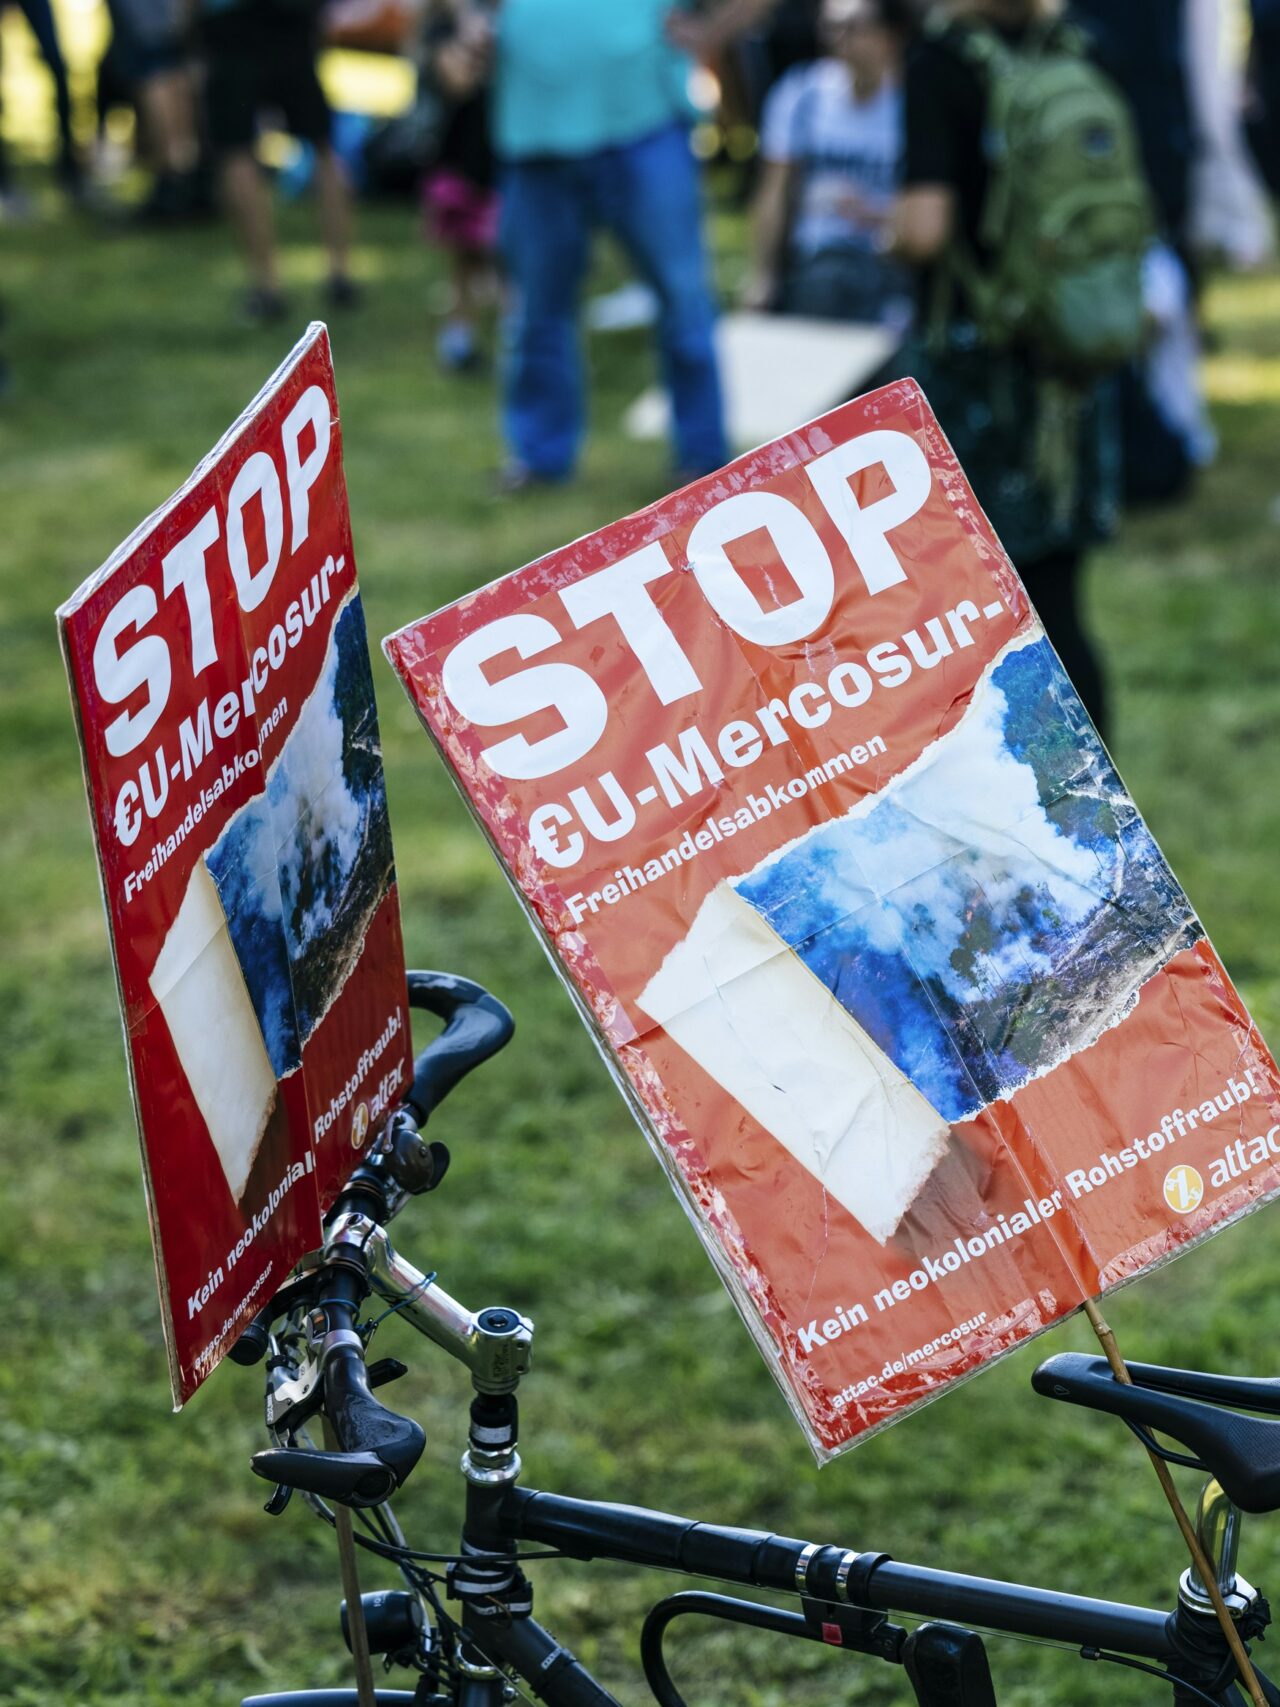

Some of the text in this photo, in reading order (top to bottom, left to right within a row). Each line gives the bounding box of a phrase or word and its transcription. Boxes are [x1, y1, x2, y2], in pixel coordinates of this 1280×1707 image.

[93, 385, 331, 758] STOP
[442, 429, 932, 780] STOP
[527, 597, 1004, 869] €U-Mercosur-
[564, 734, 887, 925] Freihandelsabkommen
[187, 1005, 402, 1320] Kein neokolonial Rohstoffraub!
[797, 1069, 1260, 1353] Kein neokolonialer Rohstoffraub!
[831, 1309, 988, 1410] attac.de/mercosur
